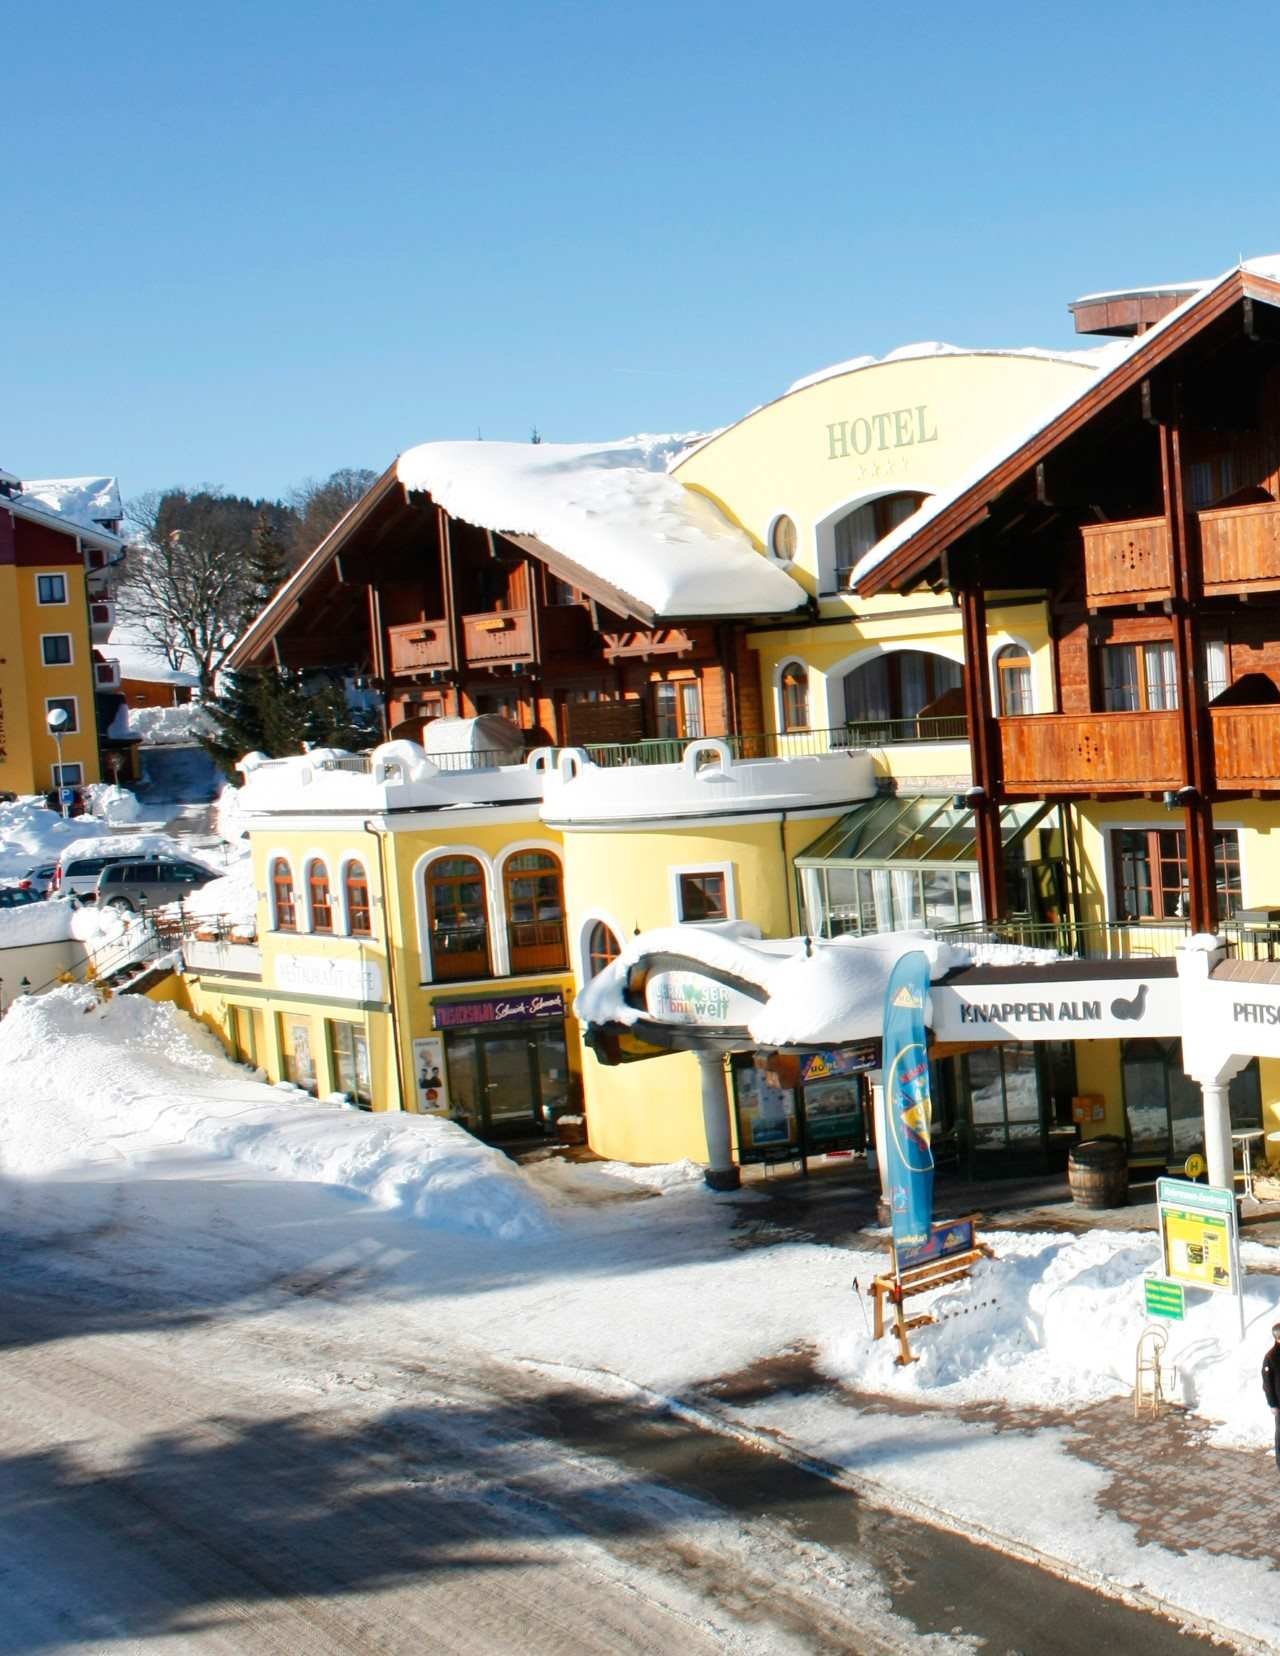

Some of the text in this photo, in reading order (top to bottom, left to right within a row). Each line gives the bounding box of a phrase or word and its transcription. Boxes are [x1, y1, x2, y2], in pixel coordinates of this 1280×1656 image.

[825, 405, 938, 460] HOTEL
[960, 1001, 1102, 1023] KNAPPEN ALM
